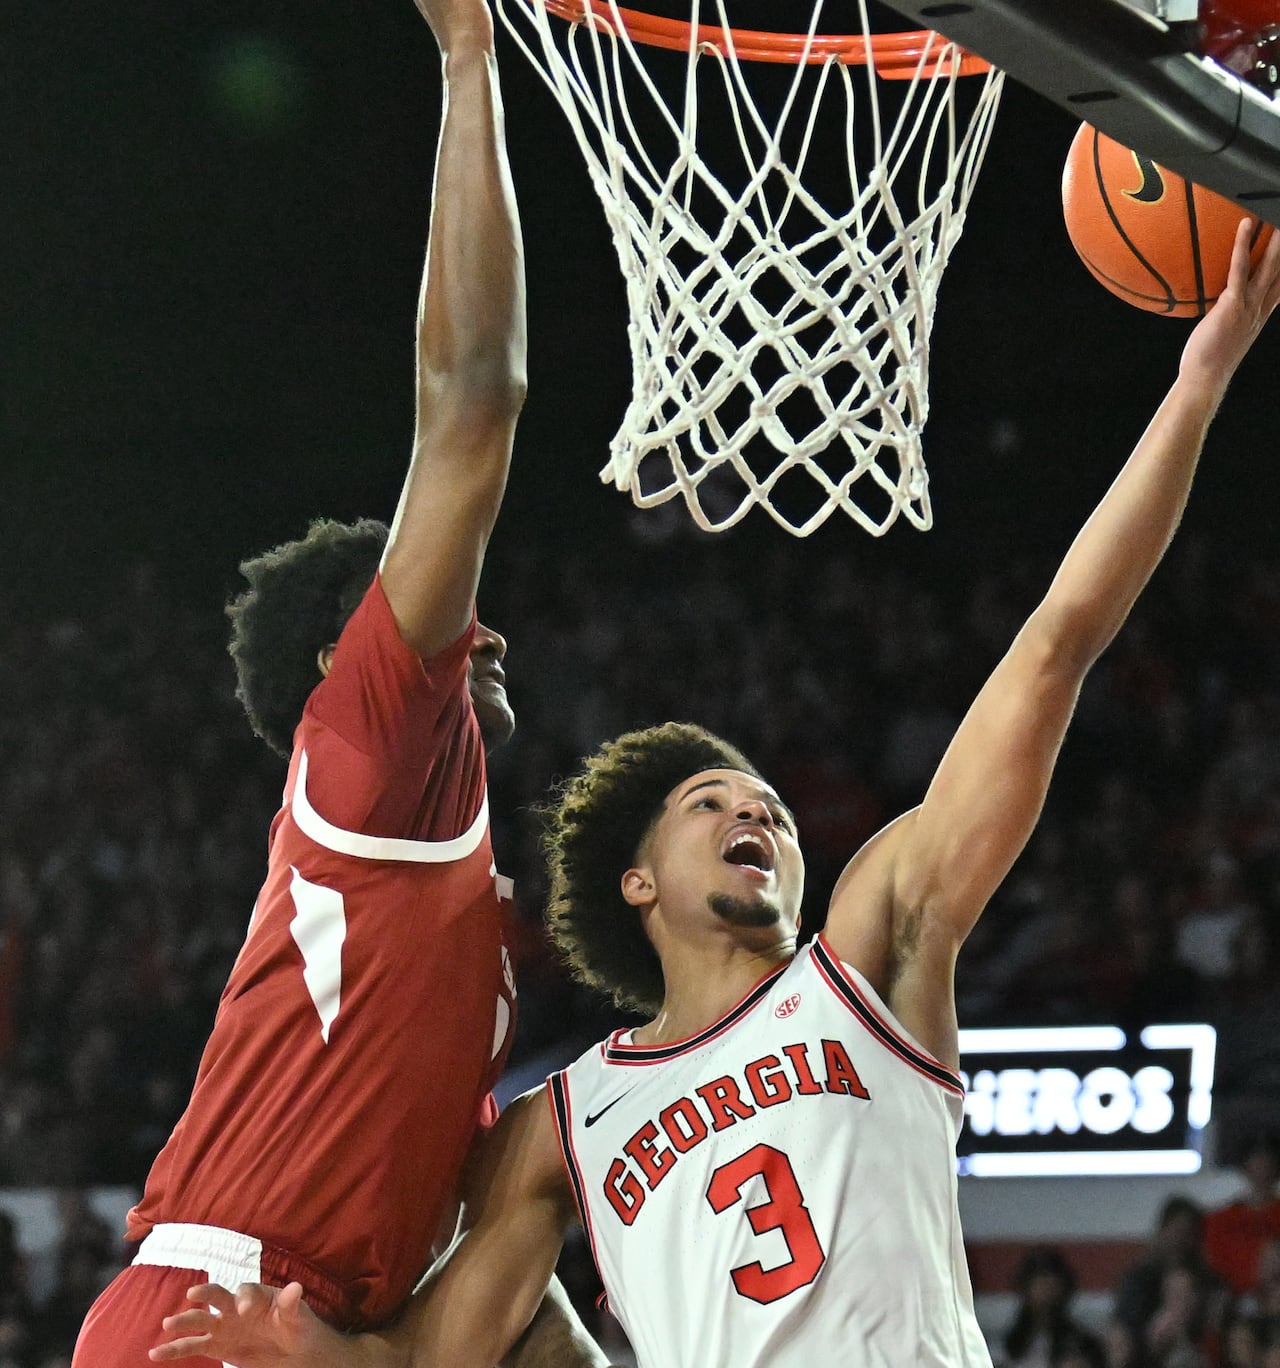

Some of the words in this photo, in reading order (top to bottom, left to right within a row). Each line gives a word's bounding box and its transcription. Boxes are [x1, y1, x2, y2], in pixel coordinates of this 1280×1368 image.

[777, 996, 799, 1016] SEC
[604, 1039, 872, 1226] GEORGIA
[705, 1143, 826, 1305] 3
